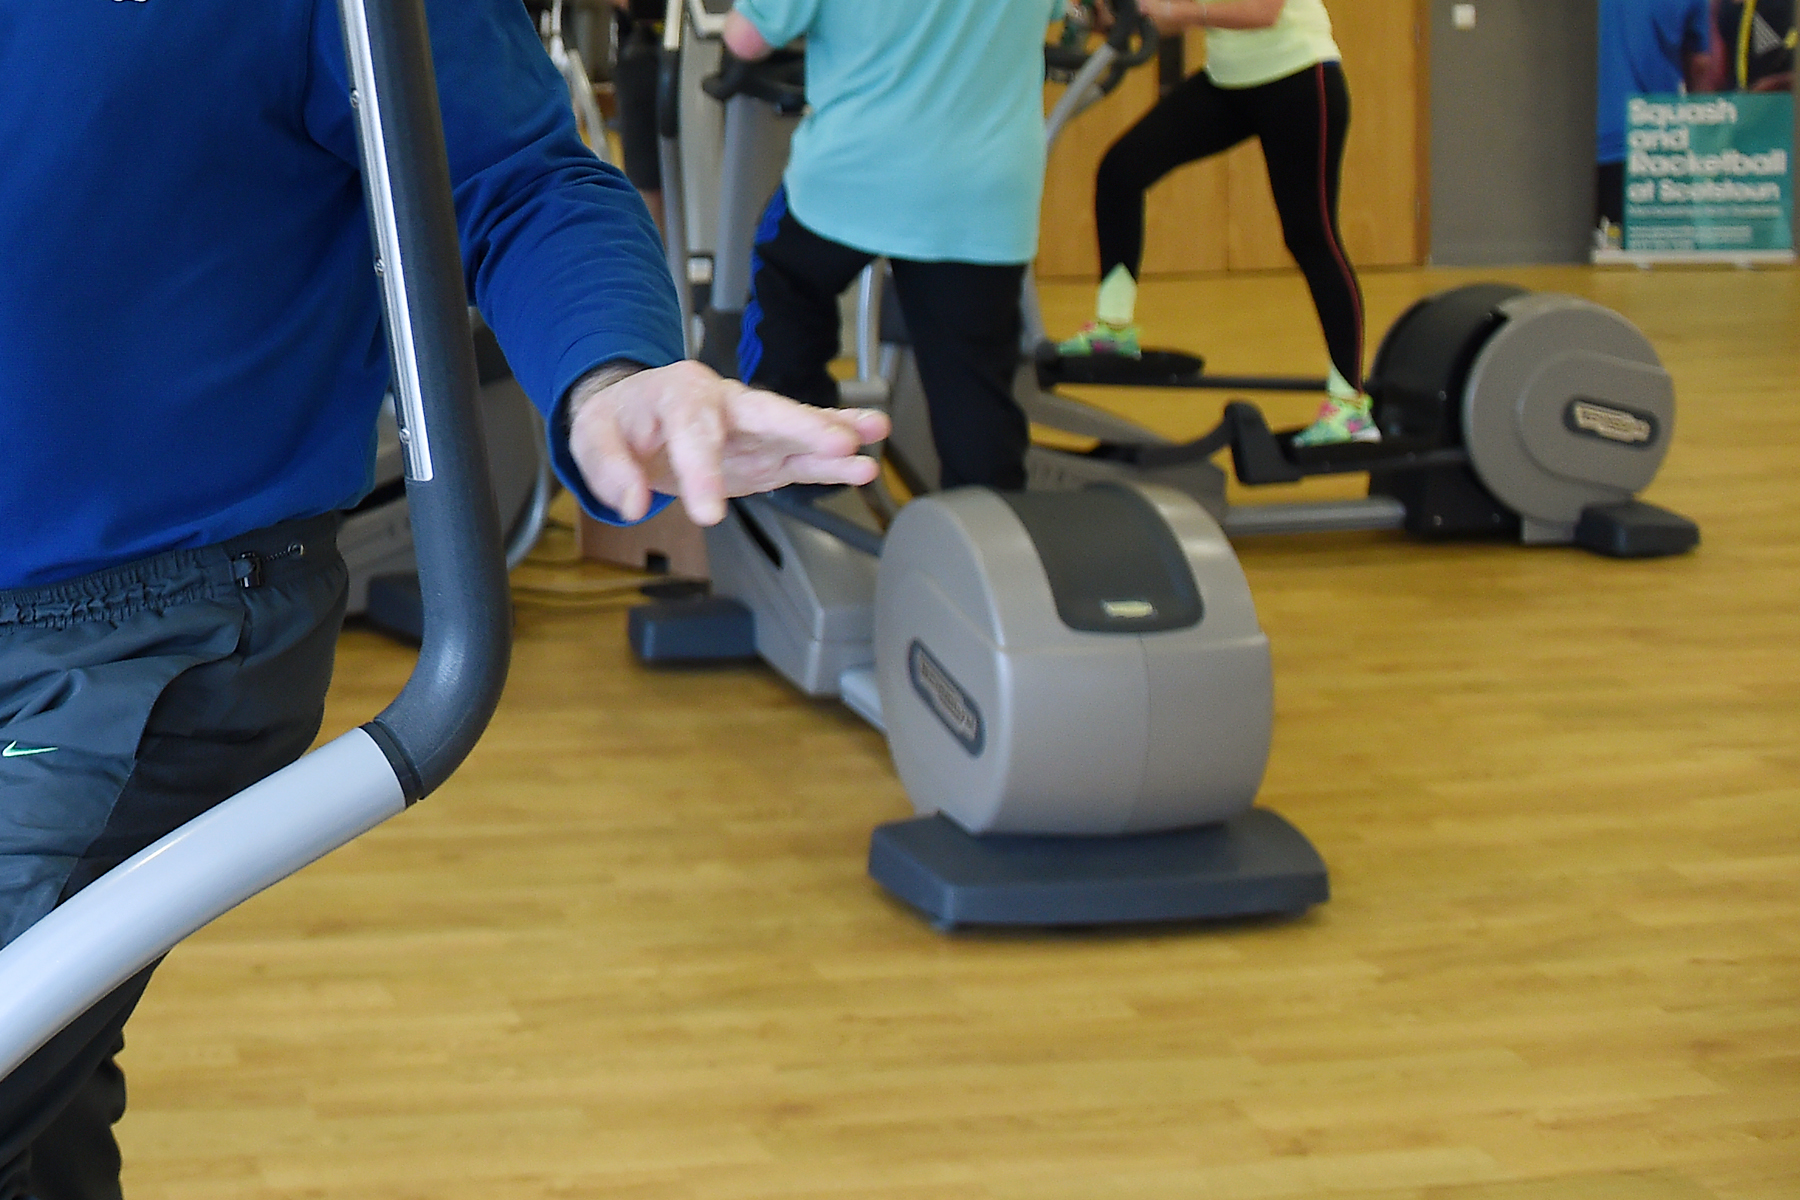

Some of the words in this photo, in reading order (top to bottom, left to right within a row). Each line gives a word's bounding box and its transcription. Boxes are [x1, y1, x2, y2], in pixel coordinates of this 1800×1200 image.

[1628, 98, 1738, 126] Squash
[1628, 128, 1690, 150] and
[1627, 180, 1656, 202] at
